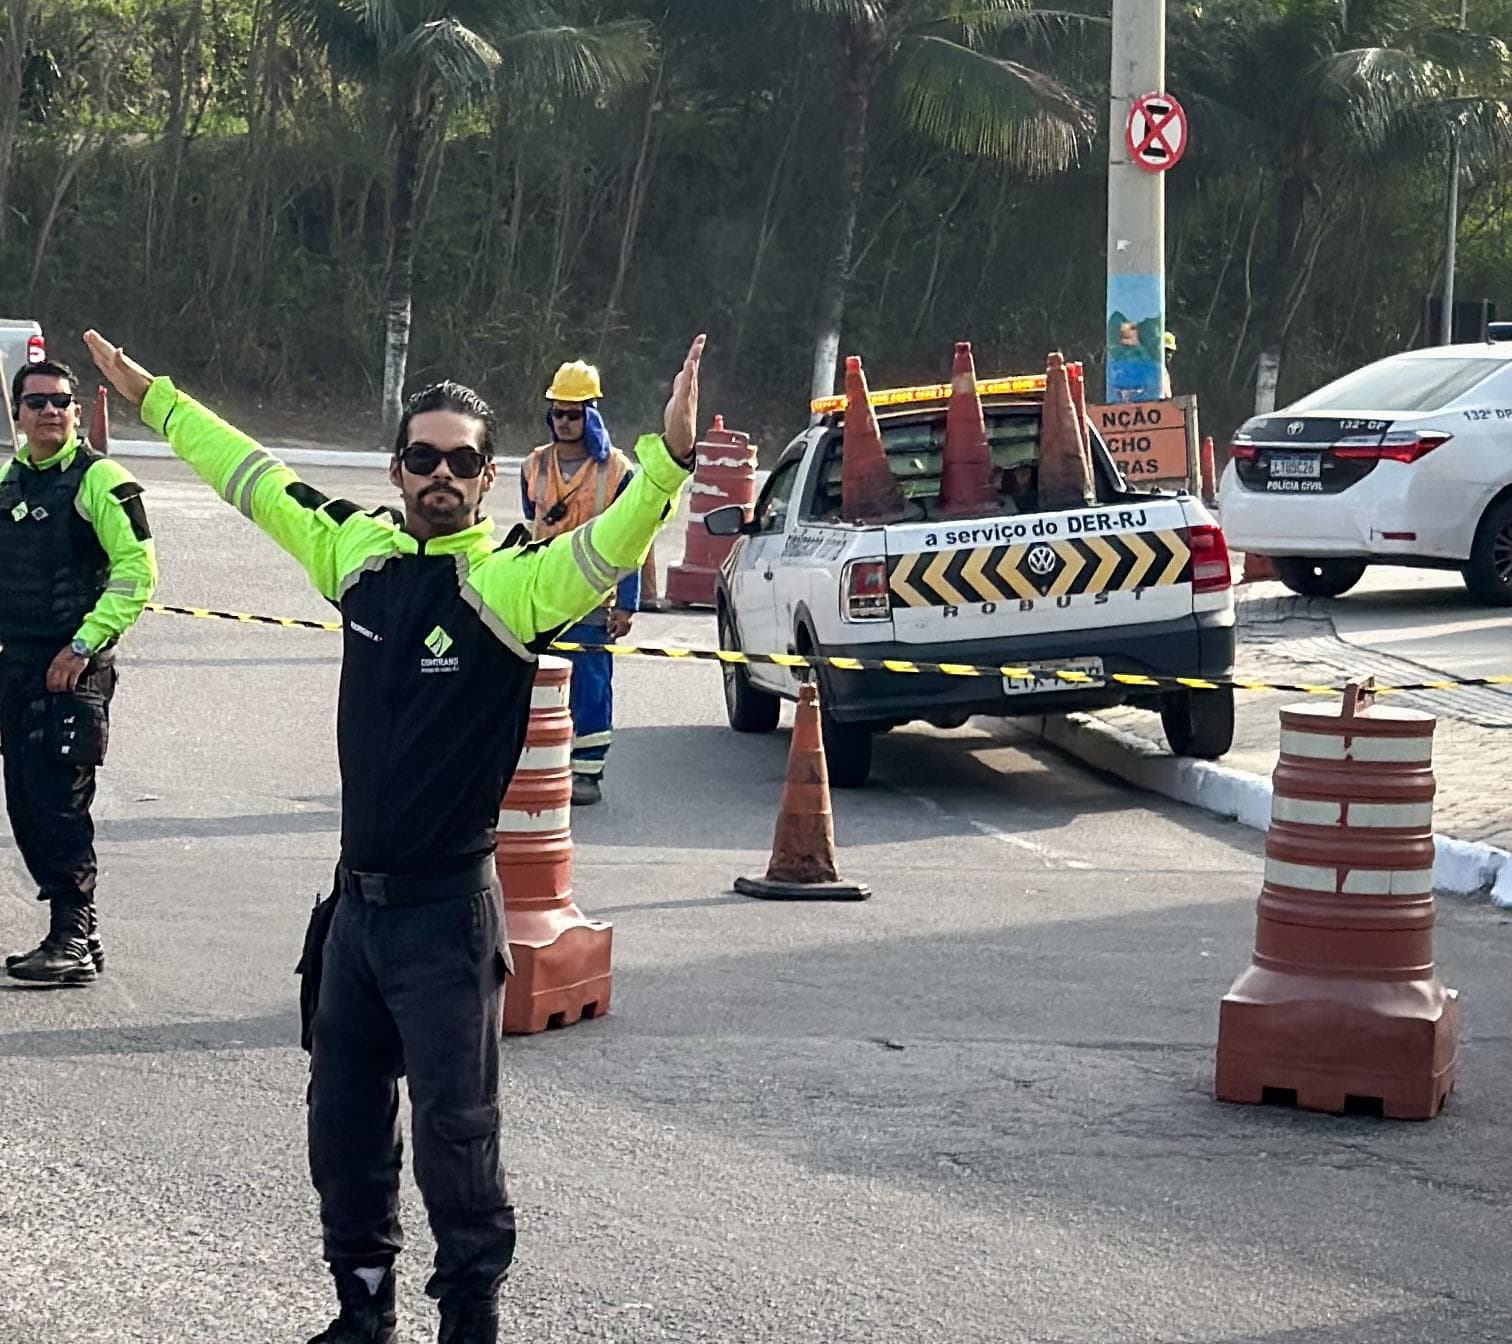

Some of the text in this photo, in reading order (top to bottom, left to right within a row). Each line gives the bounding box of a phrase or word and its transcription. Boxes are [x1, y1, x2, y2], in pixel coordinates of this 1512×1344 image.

[1102, 407, 1162, 430] NÇÃO
[1108, 436, 1152, 453] CHO
[1116, 459, 1159, 474] RAS
[925, 509, 1148, 546] a serviço do DER-RJ
